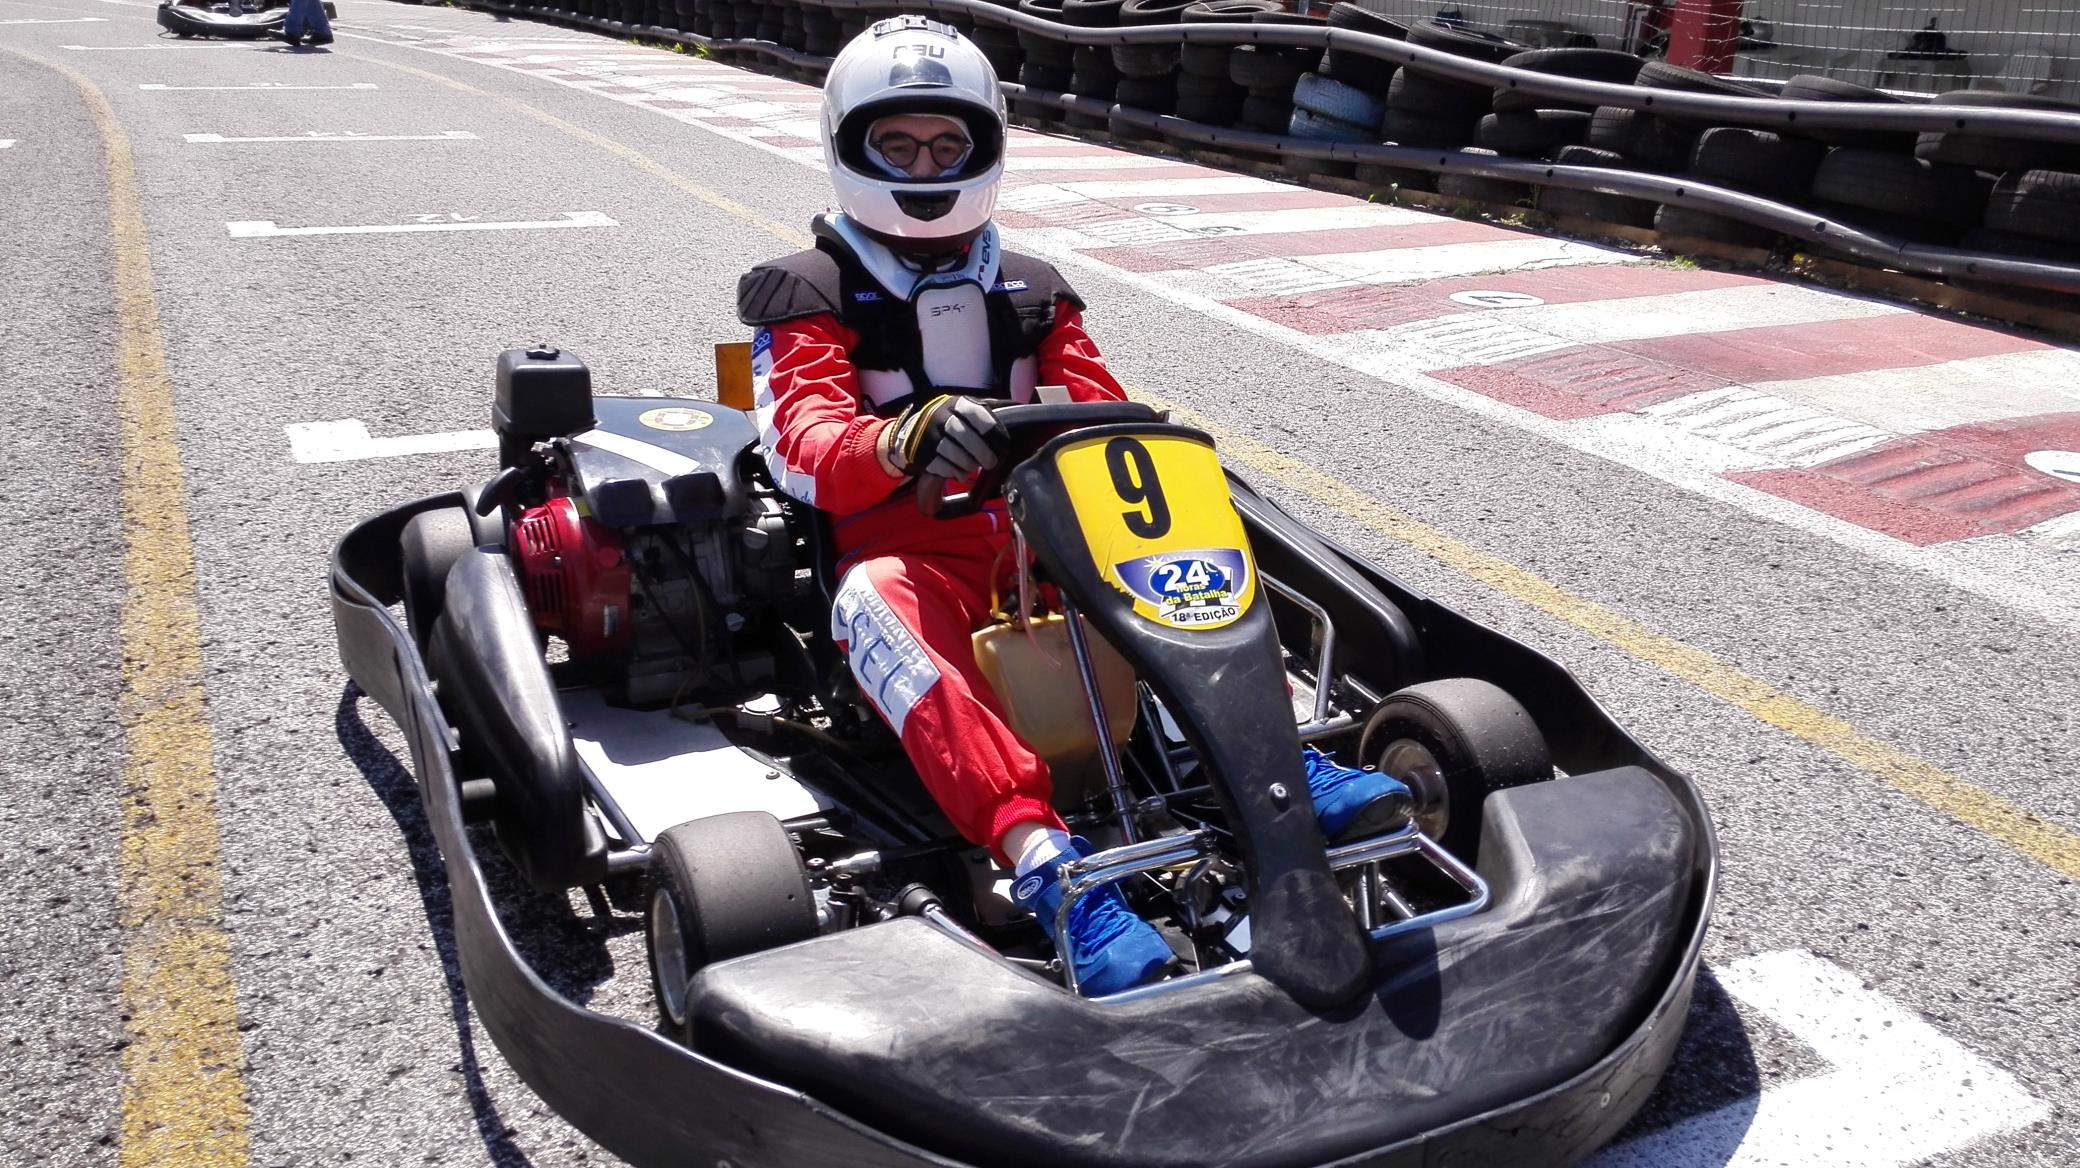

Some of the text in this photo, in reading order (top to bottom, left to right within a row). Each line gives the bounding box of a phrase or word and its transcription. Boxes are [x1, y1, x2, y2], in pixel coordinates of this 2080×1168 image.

[1105, 436, 1172, 540] 9
[1159, 560, 1211, 592] 24
[1165, 588, 1229, 606] da Batalha
[1193, 606, 1236, 622] EDIÇÃO
